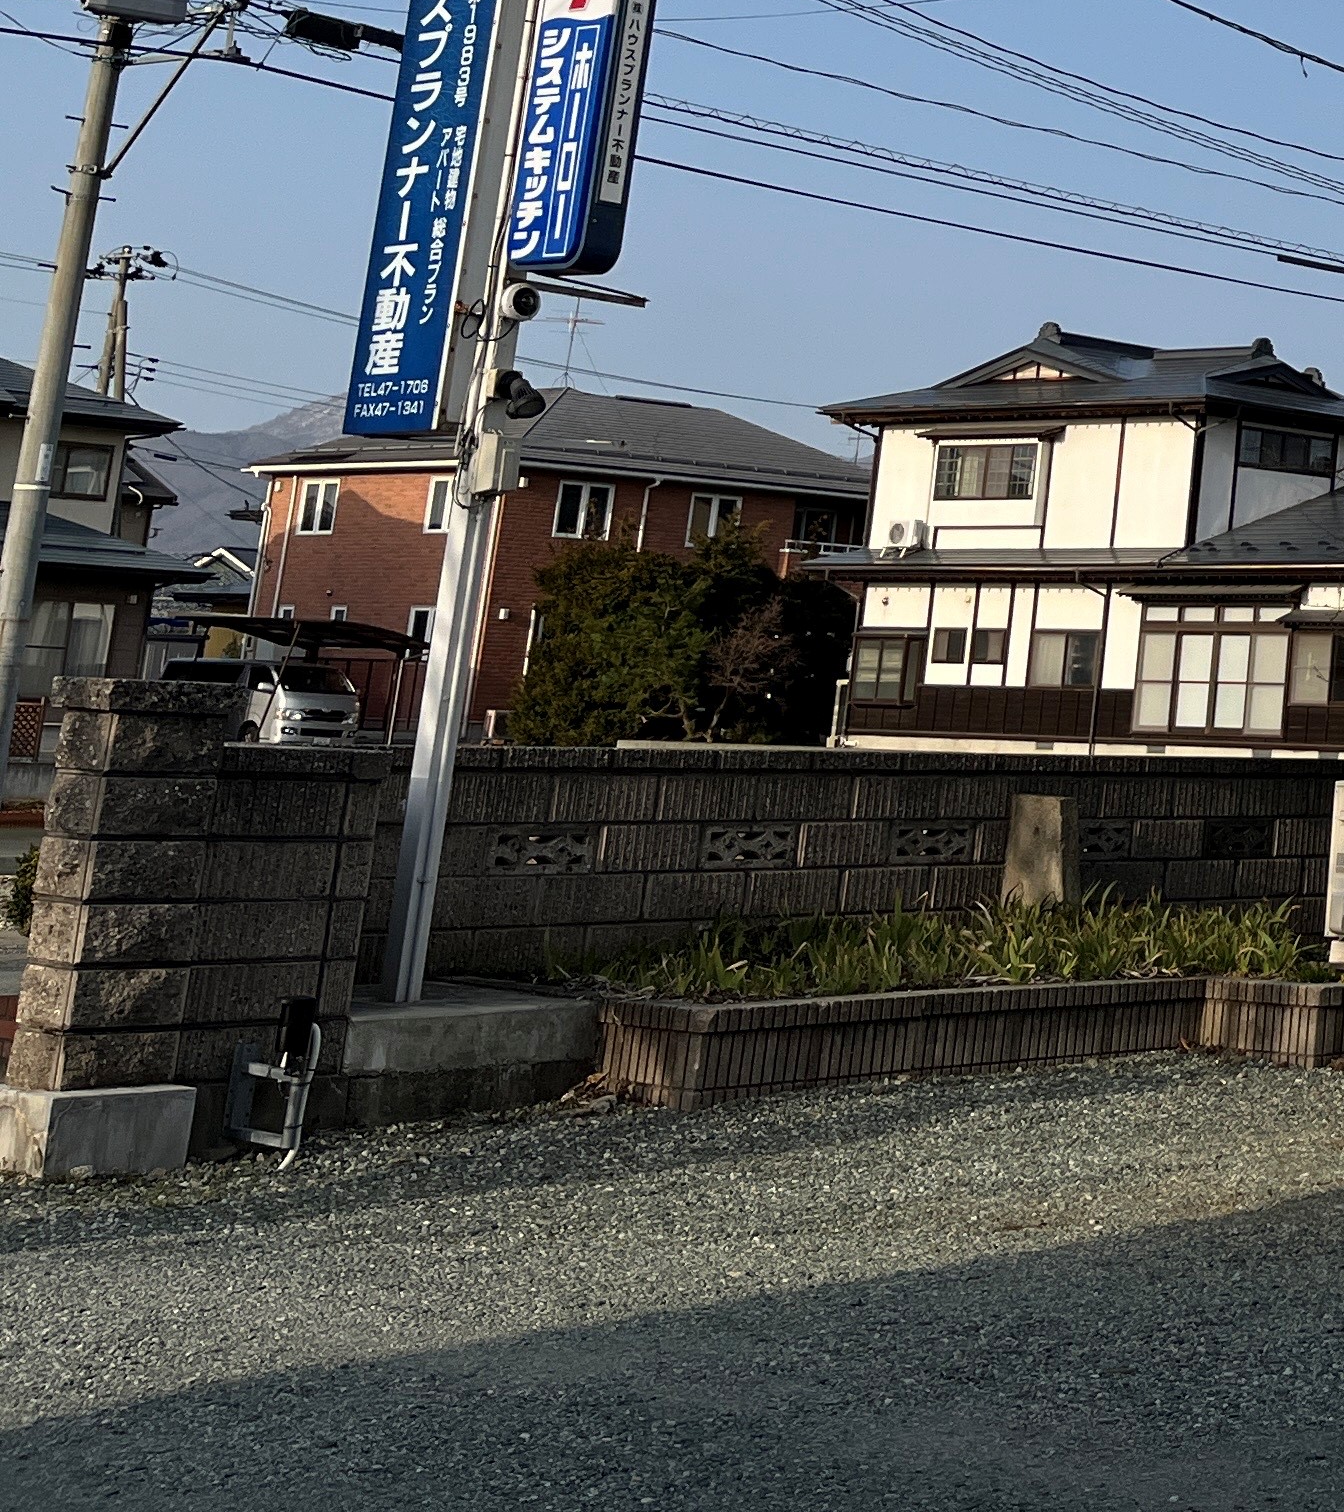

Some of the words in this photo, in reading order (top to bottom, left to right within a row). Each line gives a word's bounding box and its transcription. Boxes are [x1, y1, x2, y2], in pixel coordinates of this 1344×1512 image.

[511, 27, 572, 260] システムキッチン
[554, 42, 593, 240] ホーロー
